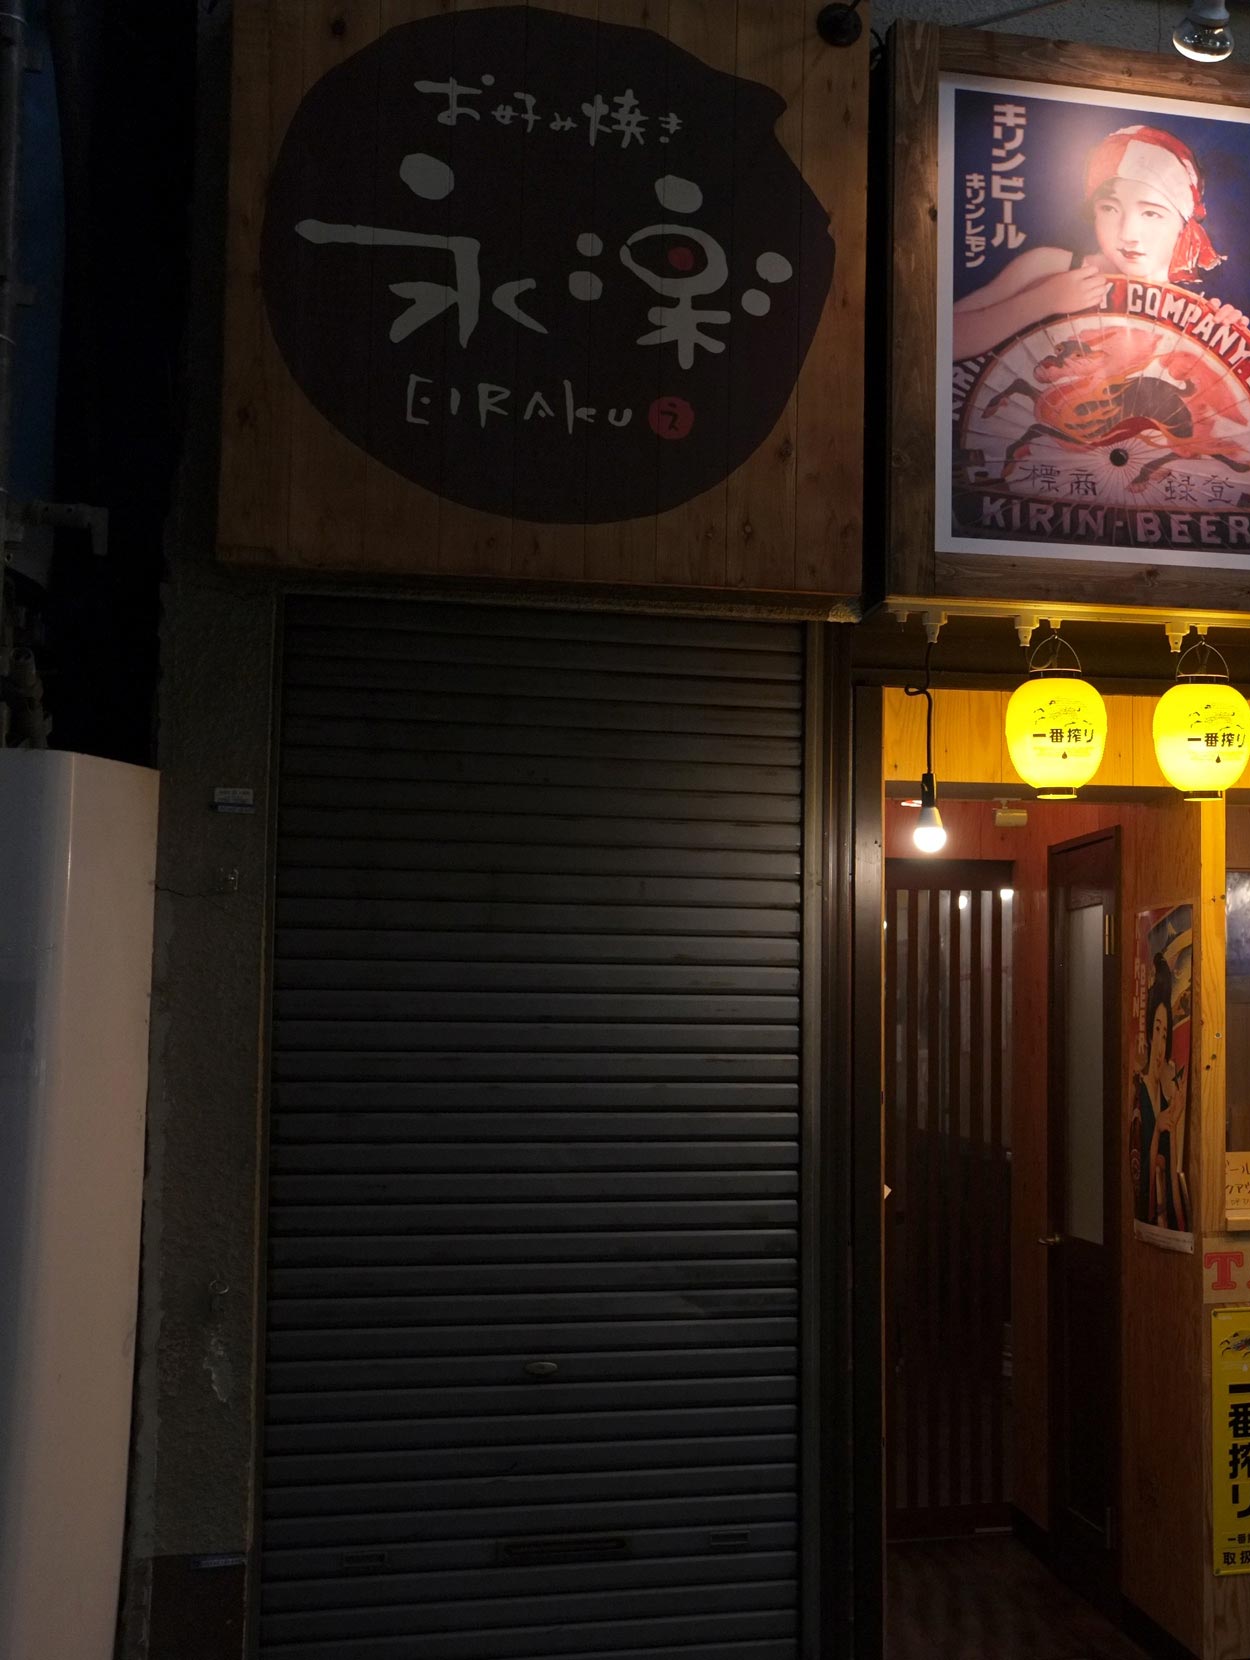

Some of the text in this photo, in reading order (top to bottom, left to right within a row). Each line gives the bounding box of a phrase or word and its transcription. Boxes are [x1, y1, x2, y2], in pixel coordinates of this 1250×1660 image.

[413, 74, 684, 149] お好み焼き
[991, 103, 1028, 249] キリンビール
[295, 153, 793, 369] 永楽
[965, 173, 986, 268] キリンレモン
[1032, 728, 1095, 743] 一番搾り
[1187, 732, 1246, 748] 一番搾り
